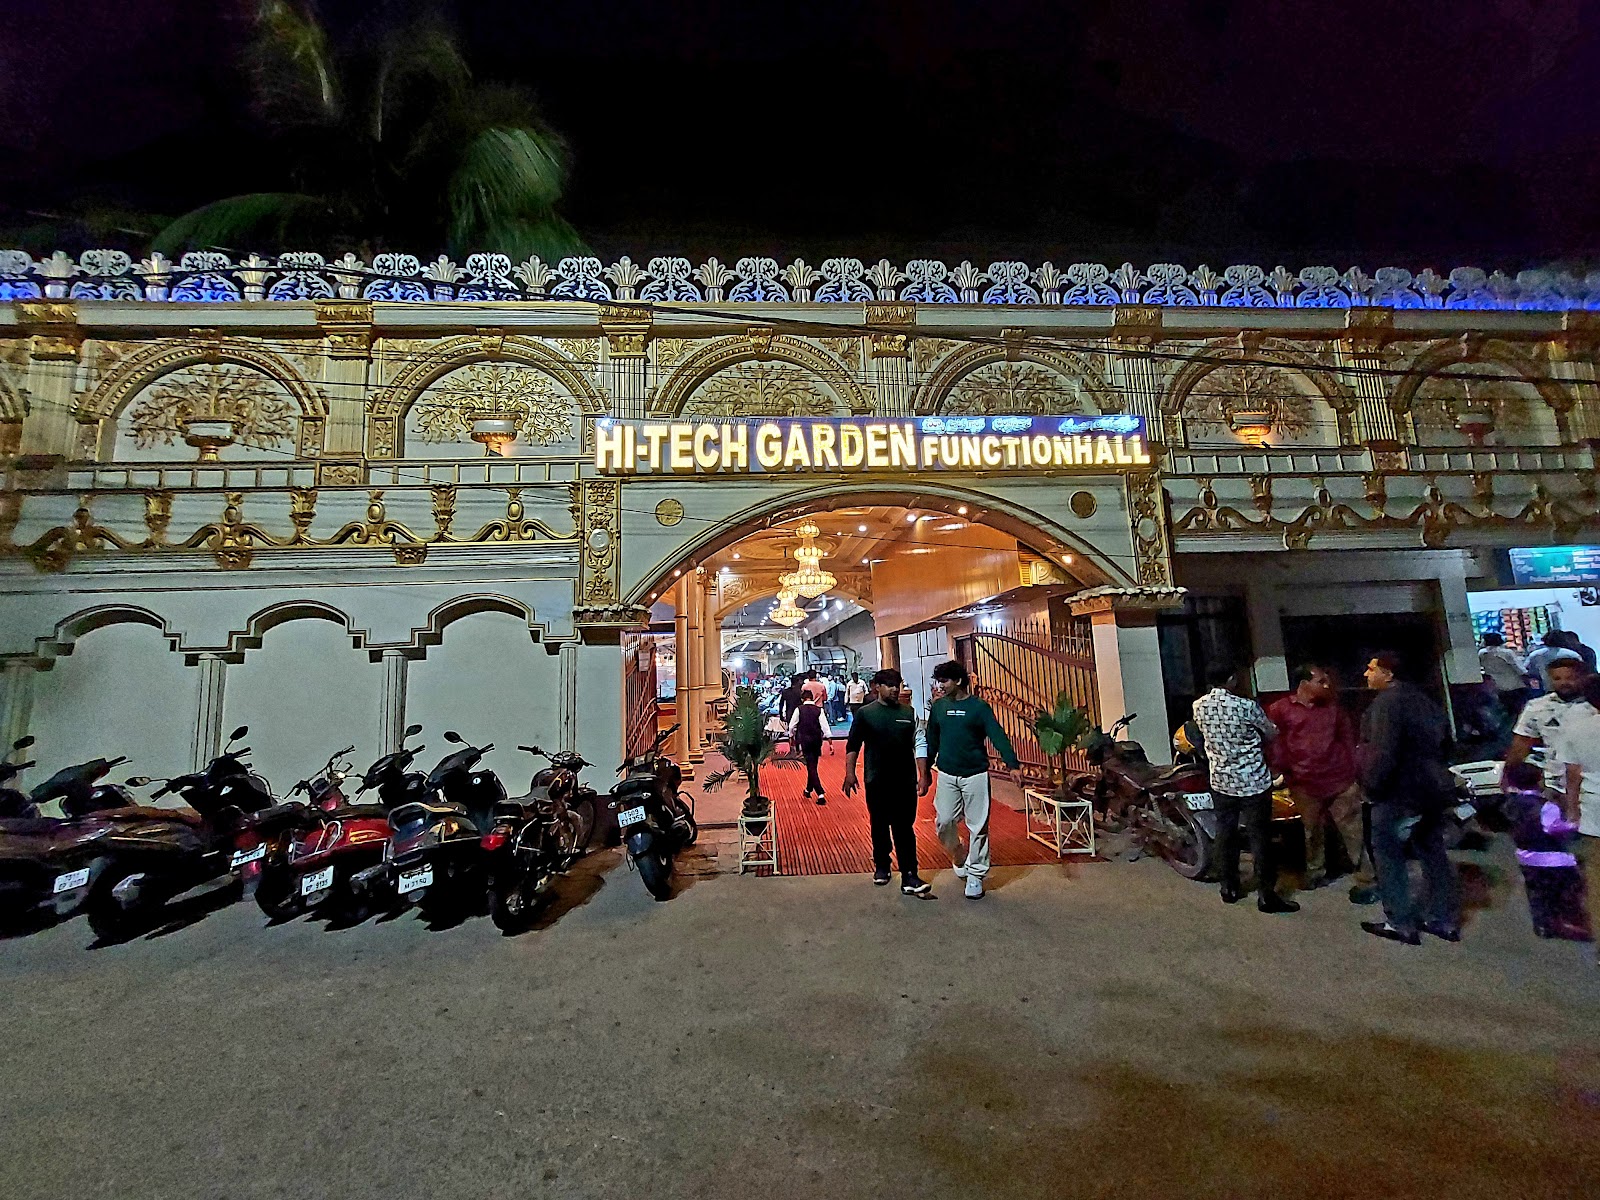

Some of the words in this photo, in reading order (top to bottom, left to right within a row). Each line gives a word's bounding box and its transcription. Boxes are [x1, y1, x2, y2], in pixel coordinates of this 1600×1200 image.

[595, 424, 747, 469] HI-TECH
[755, 424, 917, 468] GARDEN
[921, 435, 1150, 467] FUNCTIONHALL
